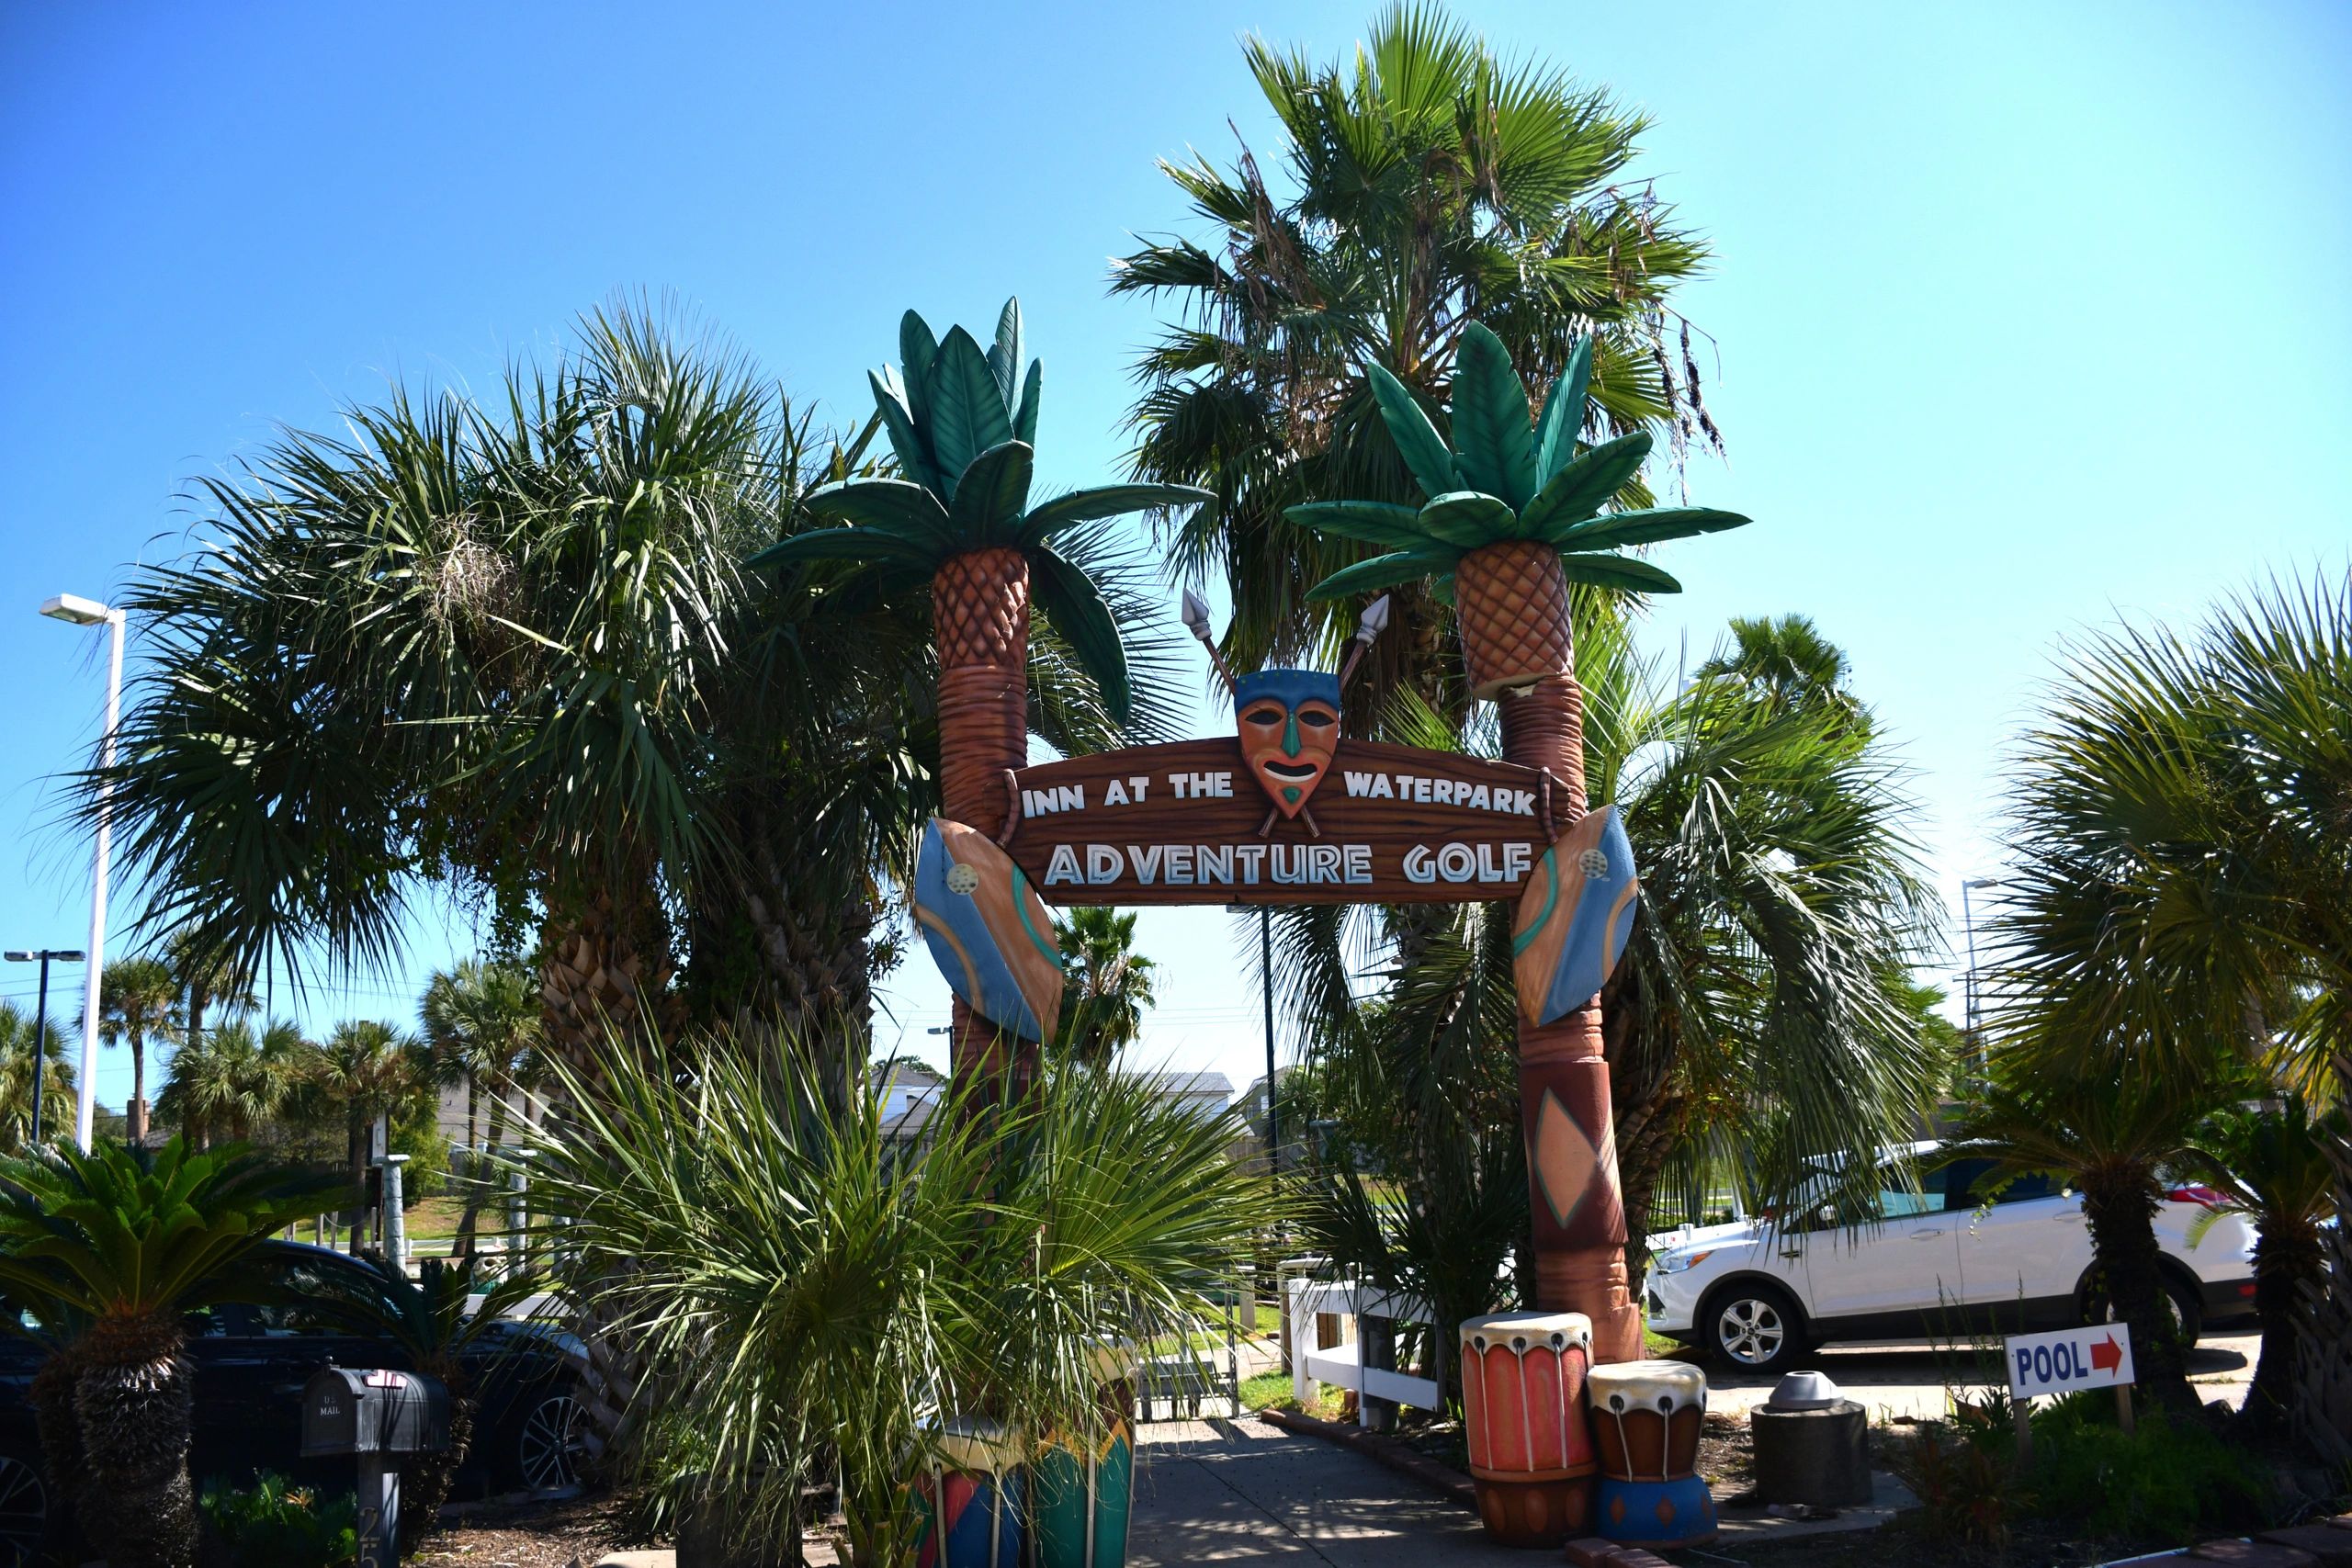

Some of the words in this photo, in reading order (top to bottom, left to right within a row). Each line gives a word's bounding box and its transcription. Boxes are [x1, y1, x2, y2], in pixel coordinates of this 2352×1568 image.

[1022, 784, 1085, 818] INN
[1104, 777, 1149, 807] AT
[1169, 772, 1233, 798] THE
[1343, 772, 1537, 816] WATERPARK
[1044, 844, 1373, 886] ADVENTURE
[1402, 842, 1532, 883] GOLF
[2016, 1341, 2088, 1386] POOL
[320, 1406, 340, 1416] MAIL
